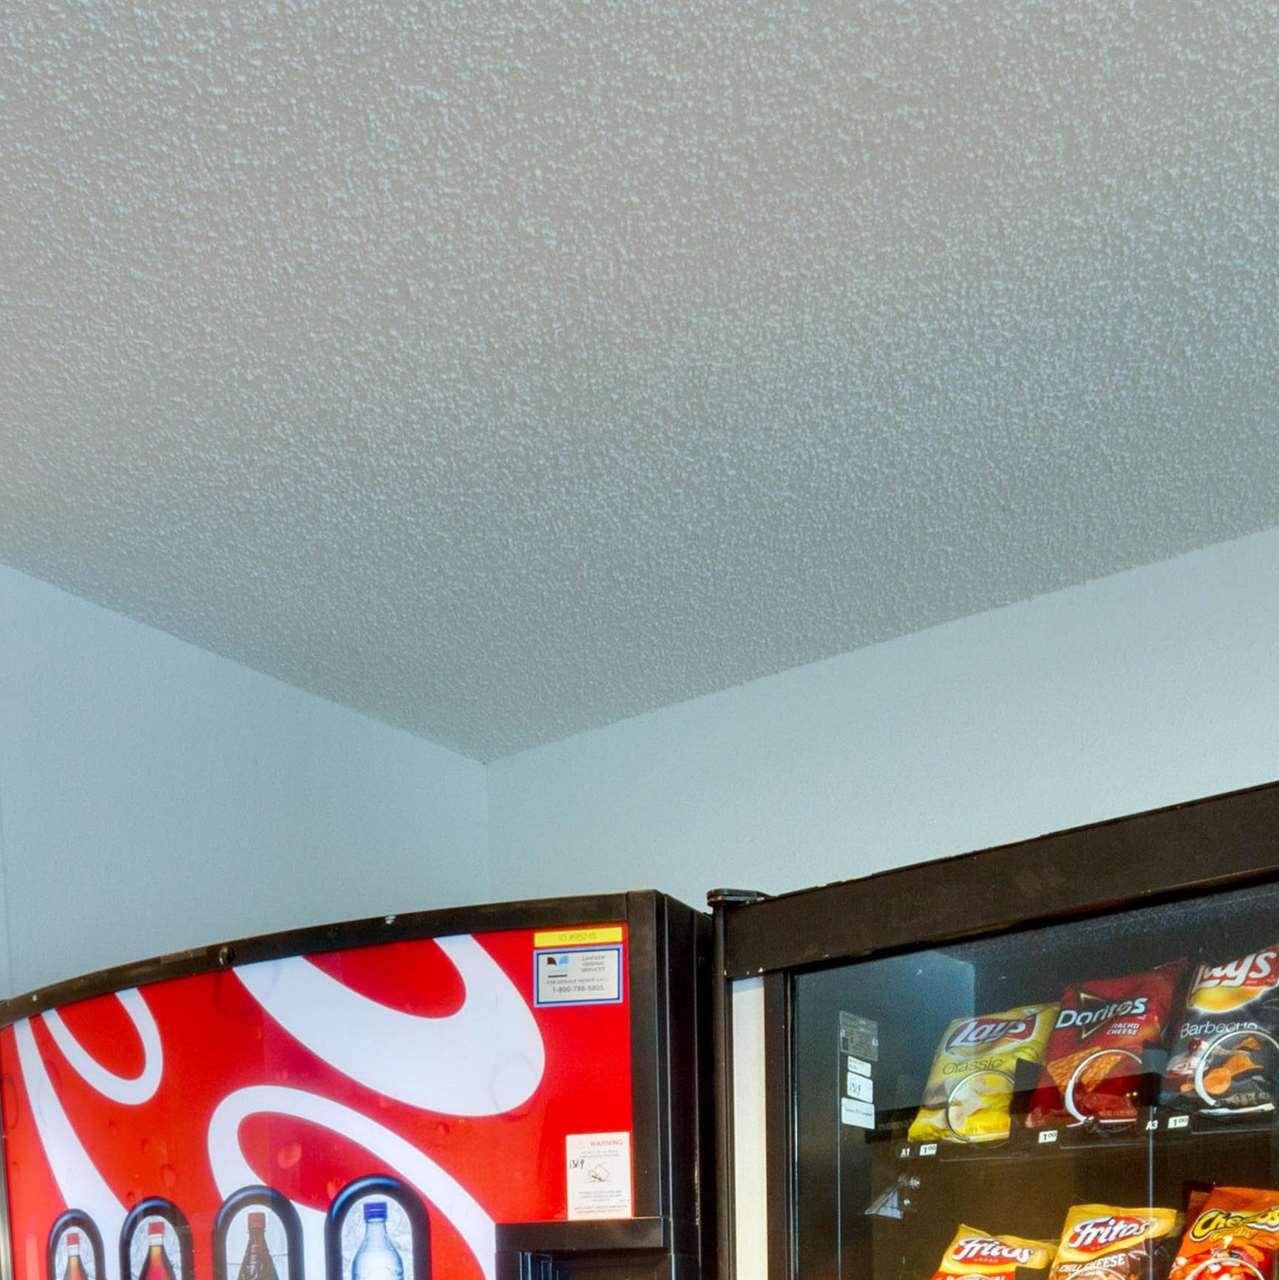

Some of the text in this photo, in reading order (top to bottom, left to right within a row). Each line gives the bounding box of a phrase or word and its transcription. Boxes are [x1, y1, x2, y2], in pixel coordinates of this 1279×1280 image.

[1055, 996, 1149, 1029] Doritos
[942, 1055, 1005, 1075] Classic
[1145, 1119, 1159, 1130] A3
[900, 1147, 911, 1158] A1
[1068, 1216, 1150, 1248] Fritos
